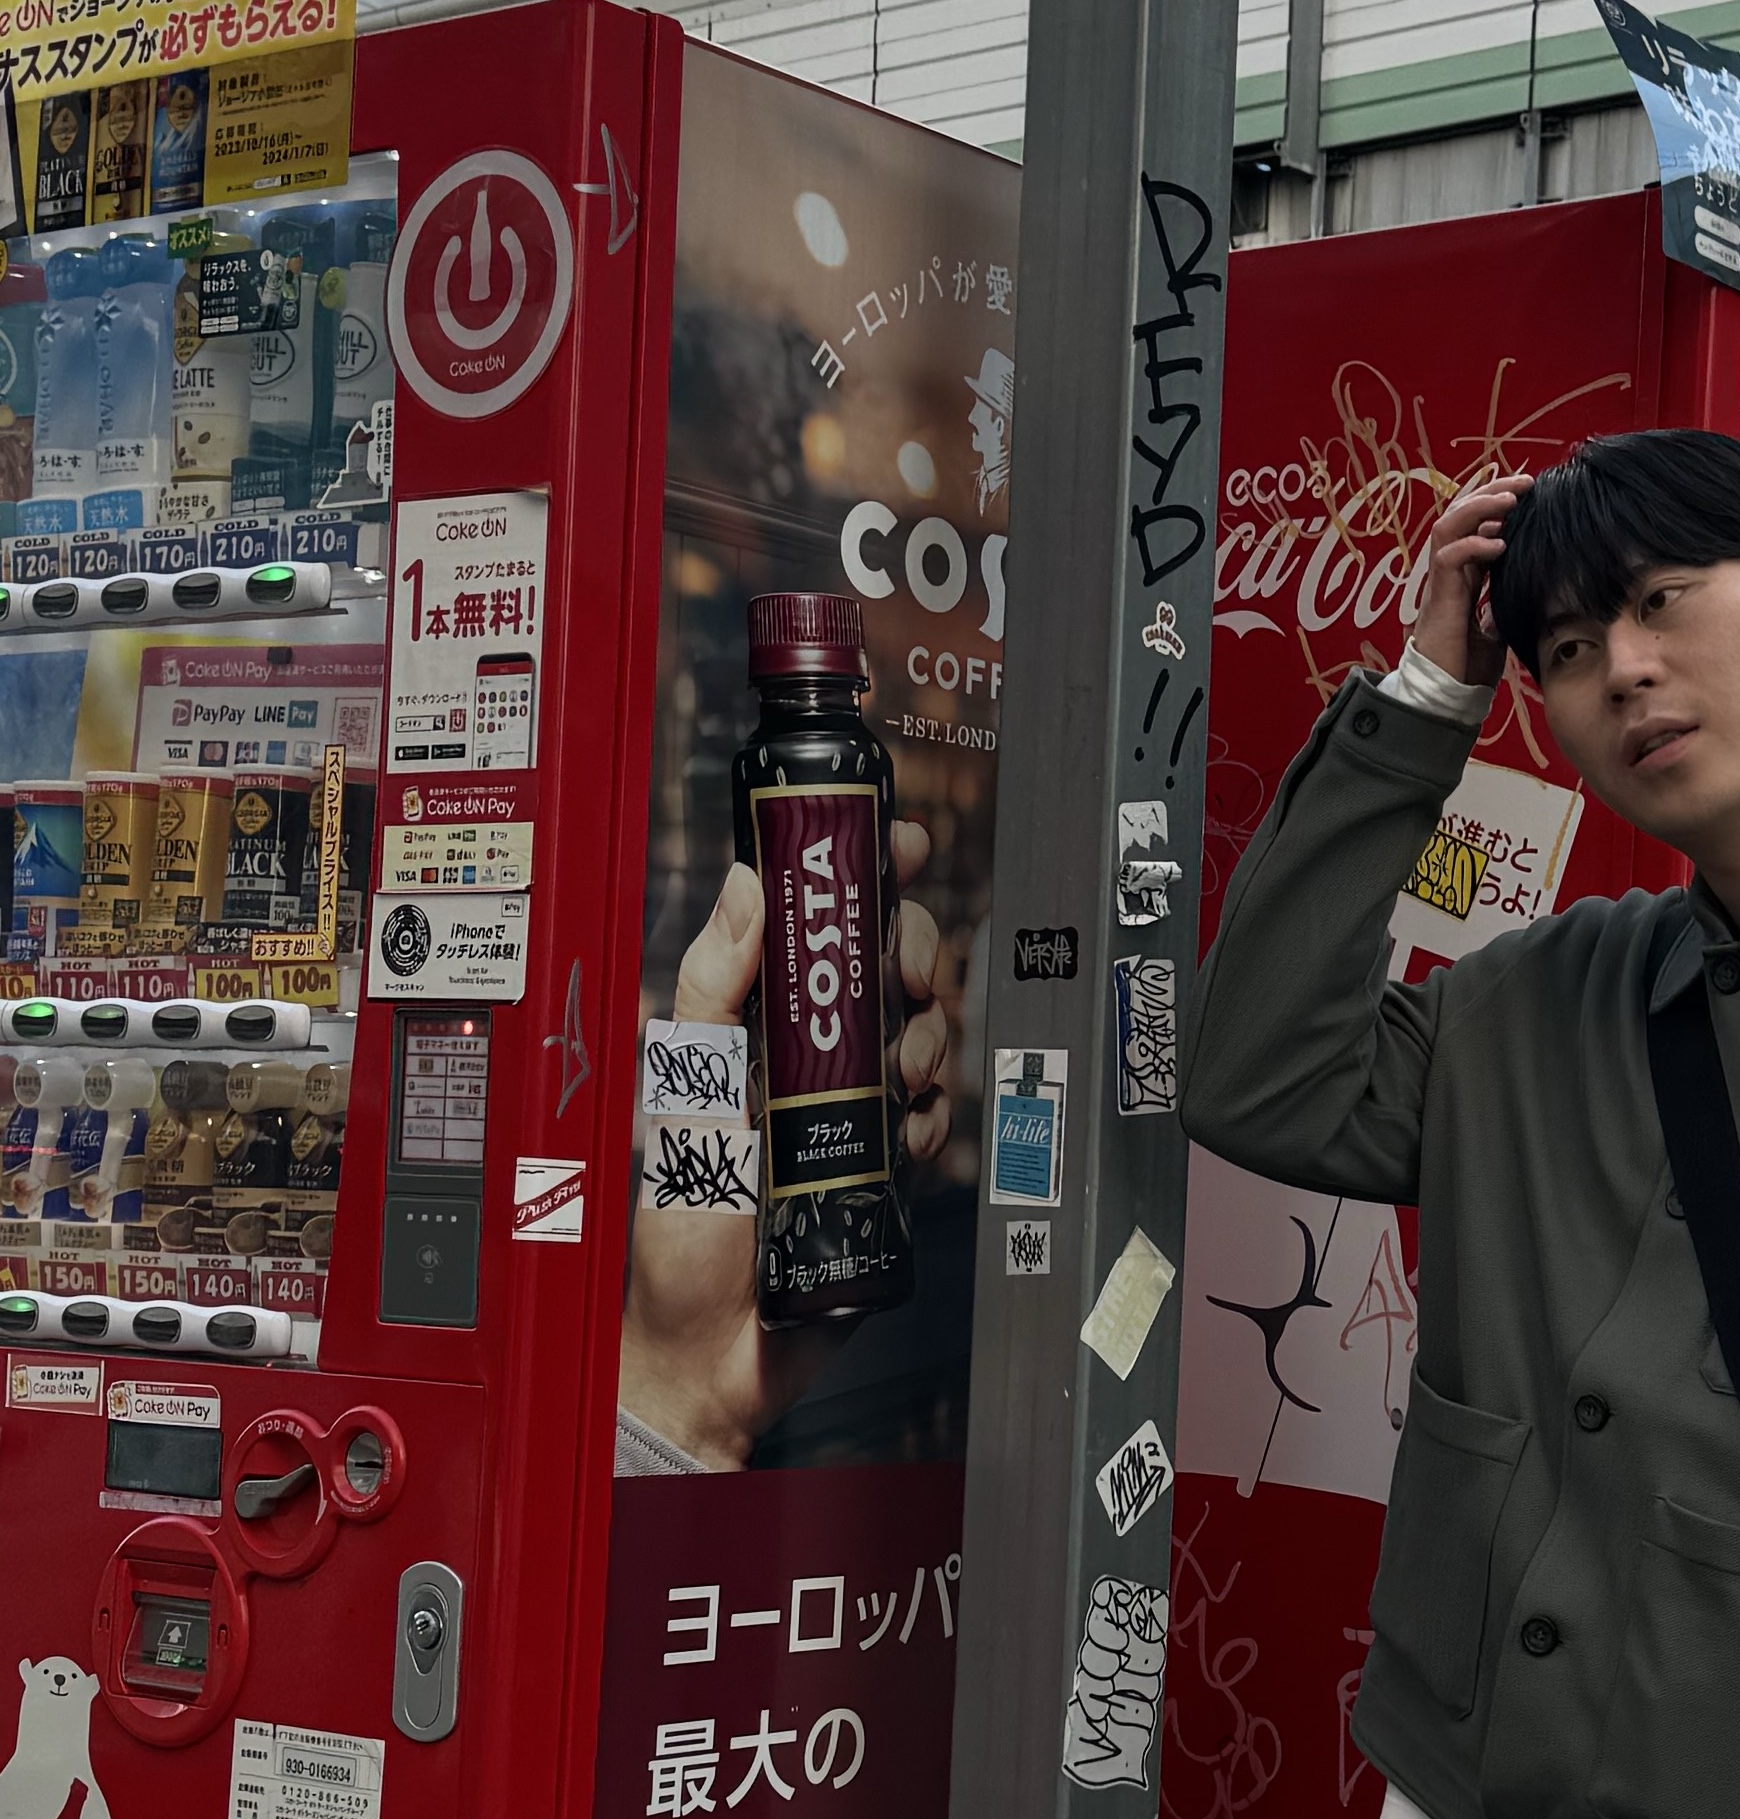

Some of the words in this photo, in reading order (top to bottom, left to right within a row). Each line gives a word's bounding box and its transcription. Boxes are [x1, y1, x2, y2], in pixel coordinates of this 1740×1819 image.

[39, 169, 83, 199] BLACK
[214, 517, 259, 532] COLD
[294, 510, 342, 525] COLD
[14, 536, 51, 549] COLD
[72, 531, 110, 544] COLD
[142, 526, 187, 540] COLD
[296, 527, 348, 554] 210円
[436, 521, 478, 543] Coke
[481, 518, 507, 539] ON
[143, 544, 196, 570] 170円
[215, 535, 266, 561] 210円
[15, 555, 59, 580] 120円
[74, 548, 119, 574] 120円
[454, 560, 536, 581] スタンプたまると
[402, 558, 536, 643] 1本無料!
[185, 660, 220, 680] Coke
[245, 661, 272, 683] Pay
[194, 704, 246, 725] PayPay
[254, 706, 285, 723] LINE
[427, 798, 461, 816] Coke
[488, 797, 516, 819] Pay
[320, 750, 341, 932] スペシャルプライス!!
[782, 869, 795, 907] 1971
[450, 923, 506, 941] iPhoneで
[785, 910, 800, 978] LONDON
[803, 835, 843, 1053] COSTA
[846, 883, 864, 999] COFFEE
[255, 938, 315, 957] おすすめ!!
[55, 977, 105, 997] 110円
[123, 974, 174, 997] 110円
[206, 974, 252, 997] 100円
[281, 967, 331, 992] 100円
[806, 1120, 854, 1143] ブラック
[45, 1266, 95, 1290] 150円
[123, 1271, 176, 1295] 150円
[786, 1252, 898, 1291] ブラック無糖/コーヒー
[192, 1275, 246, 1299] 140円
[267, 1278, 314, 1303] 140円
[74, 1384, 92, 1399] Pay
[135, 1399, 165, 1415] Coke
[187, 1402, 211, 1422] Pay
[663, 1553, 961, 1667] ヨーロッパ
[646, 1706, 866, 1819] 最大の
